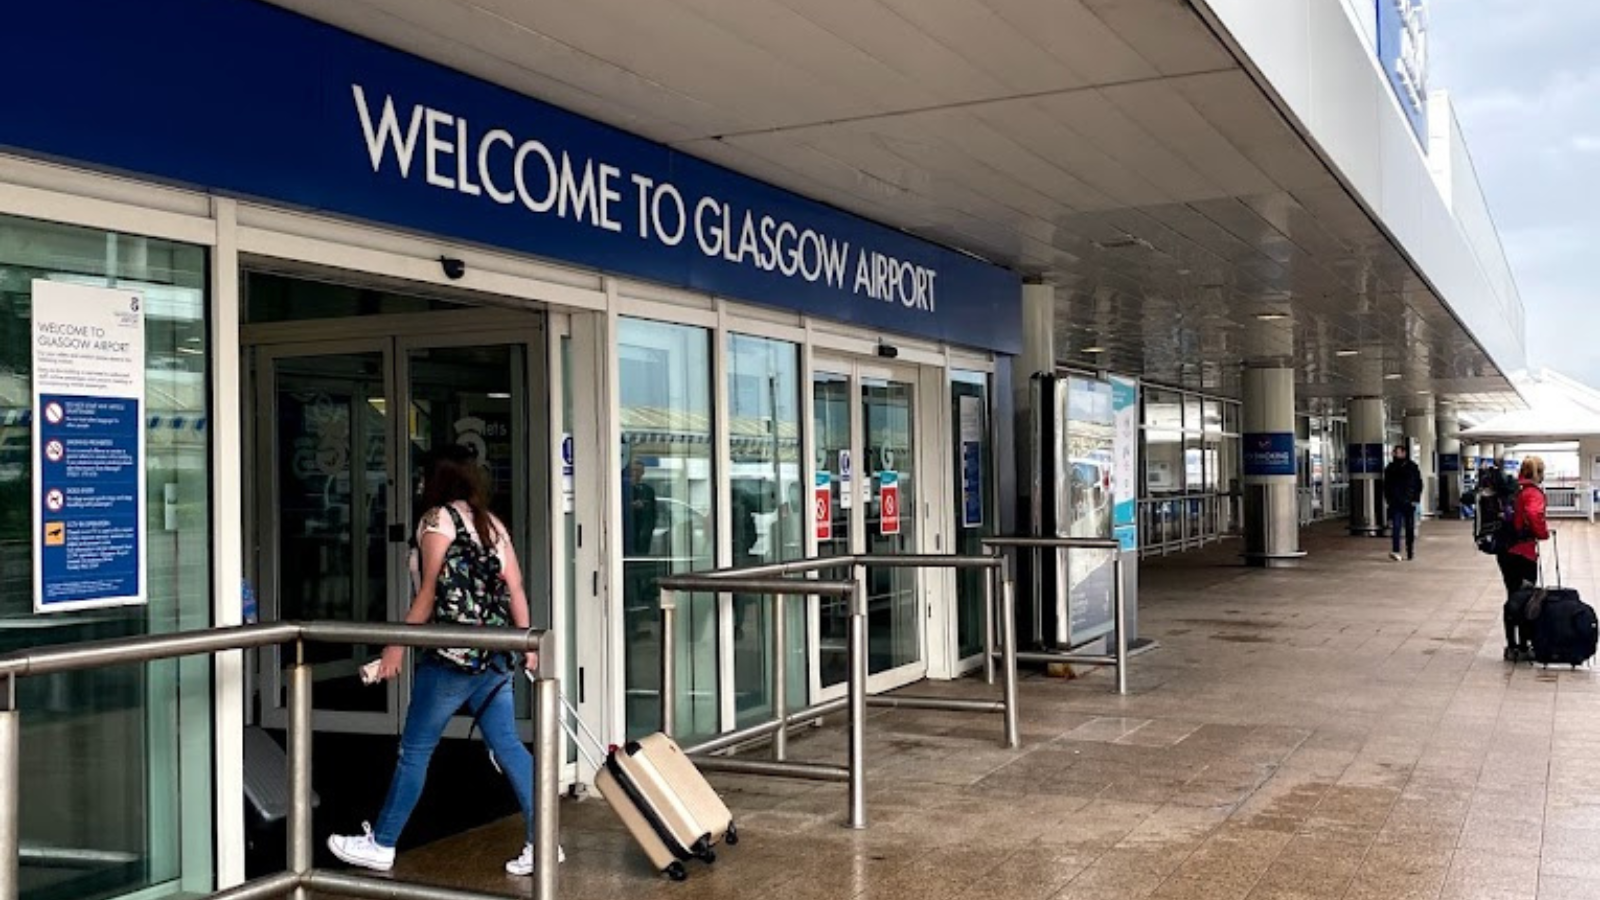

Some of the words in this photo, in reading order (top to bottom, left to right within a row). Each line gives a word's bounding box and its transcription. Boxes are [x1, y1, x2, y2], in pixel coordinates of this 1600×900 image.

[352, 84, 622, 232] WELCOME
[631, 173, 686, 246] TO
[694, 196, 849, 290] GLASGOW
[853, 248, 937, 313] AIRPORT
[38, 322, 88, 337] WELCOME
[91, 326, 105, 338] TO
[38, 335, 90, 350] GLASGOW
[93, 341, 130, 353] AIRPORT
